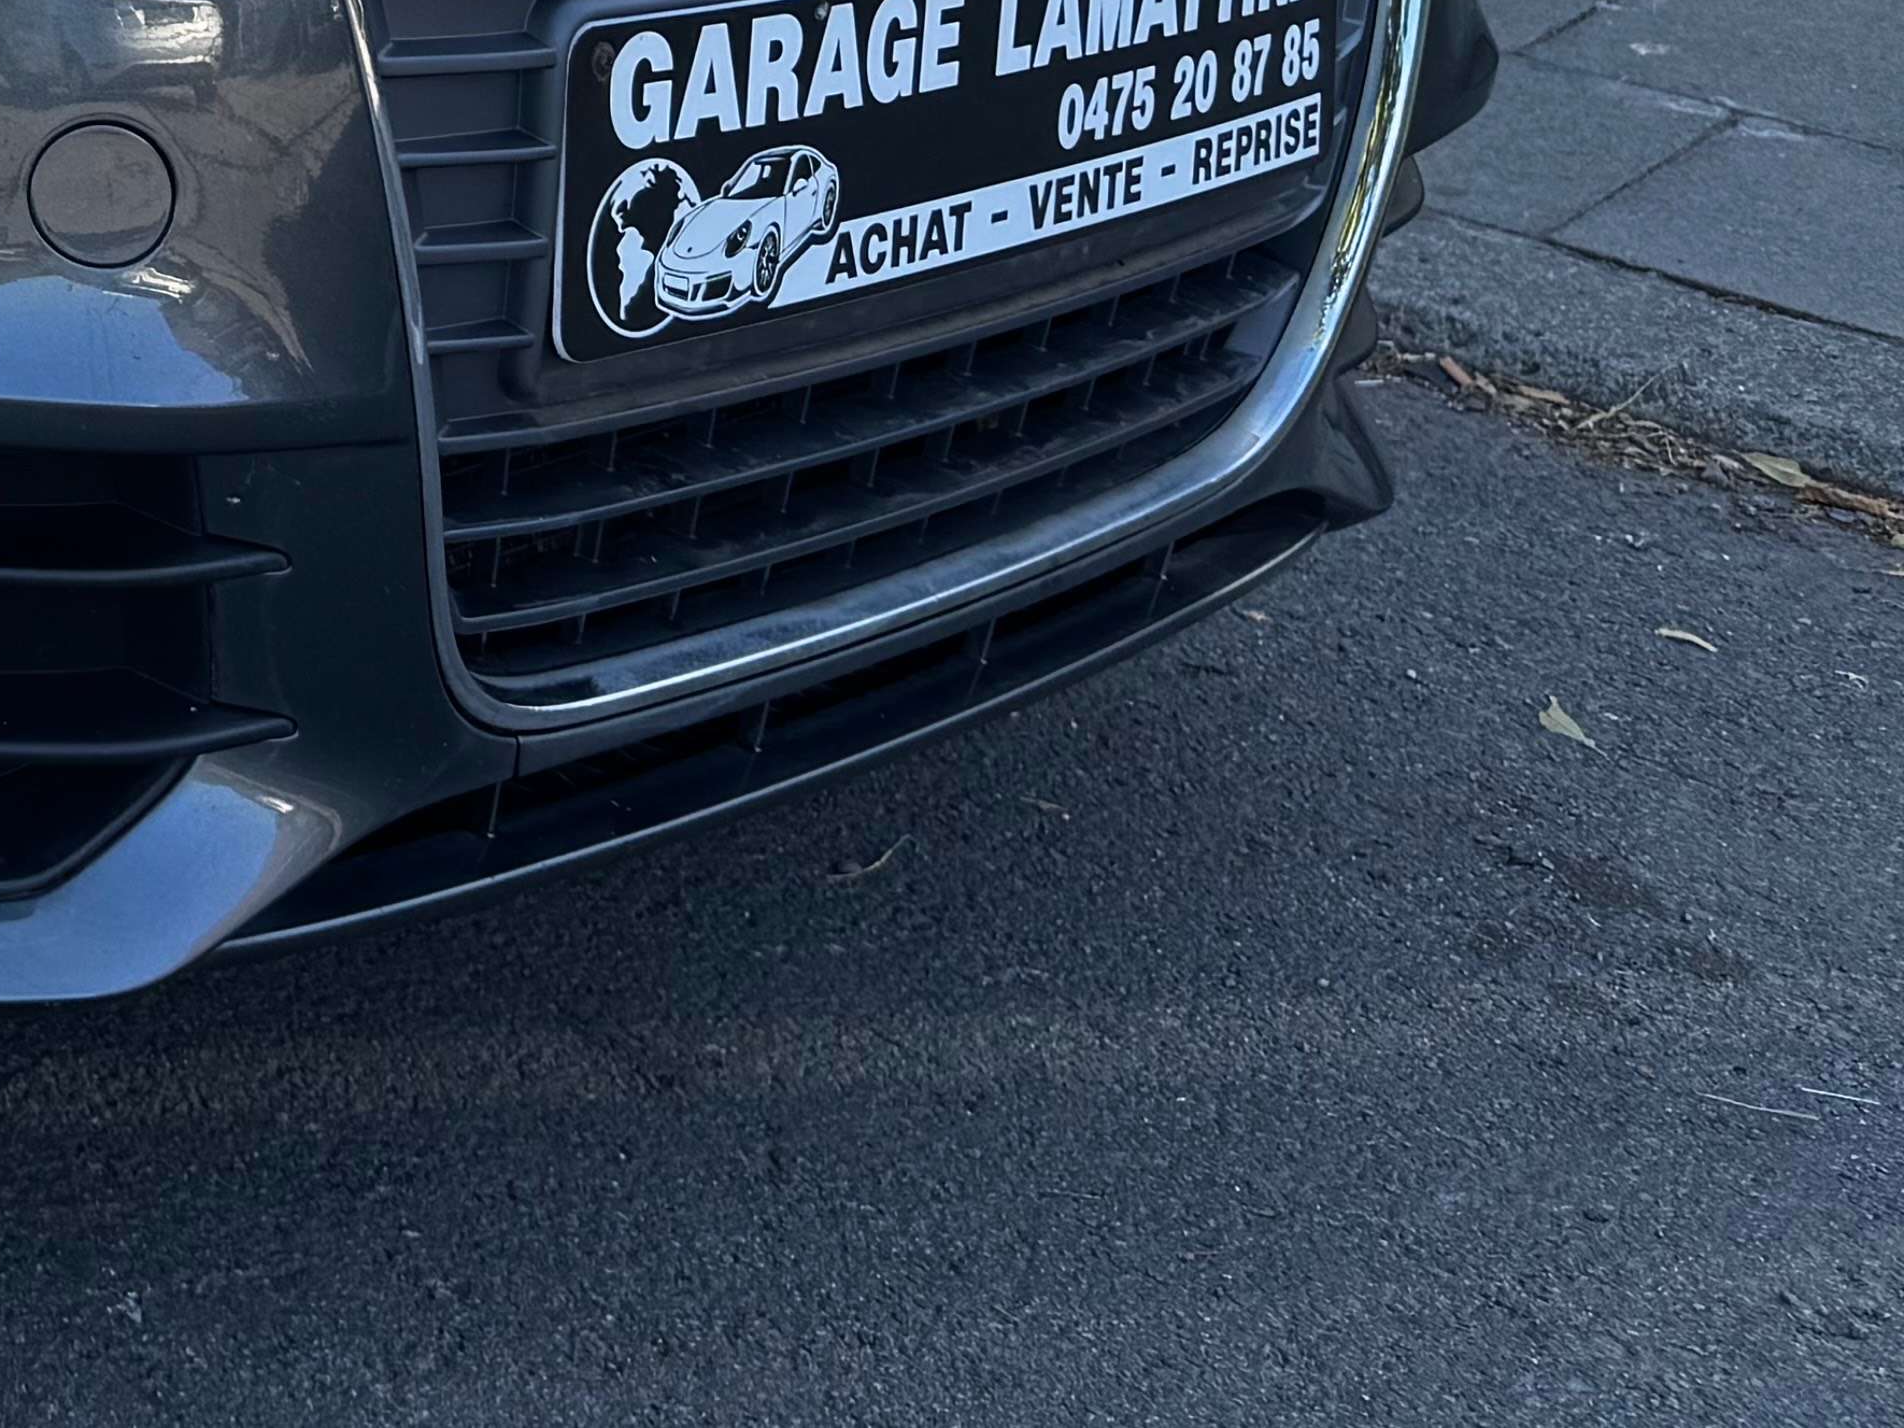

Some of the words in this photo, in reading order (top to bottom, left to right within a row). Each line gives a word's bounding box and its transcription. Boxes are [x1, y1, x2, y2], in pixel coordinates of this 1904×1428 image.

[1056, 75, 1157, 151] 0475
[1170, 54, 1219, 122] 20
[1231, 35, 1274, 106] 87
[1281, 18, 1323, 86] 85
[824, 201, 975, 285] ACHAT
[1028, 155, 1144, 233] VENTE
[1191, 101, 1320, 187] REPRISE
